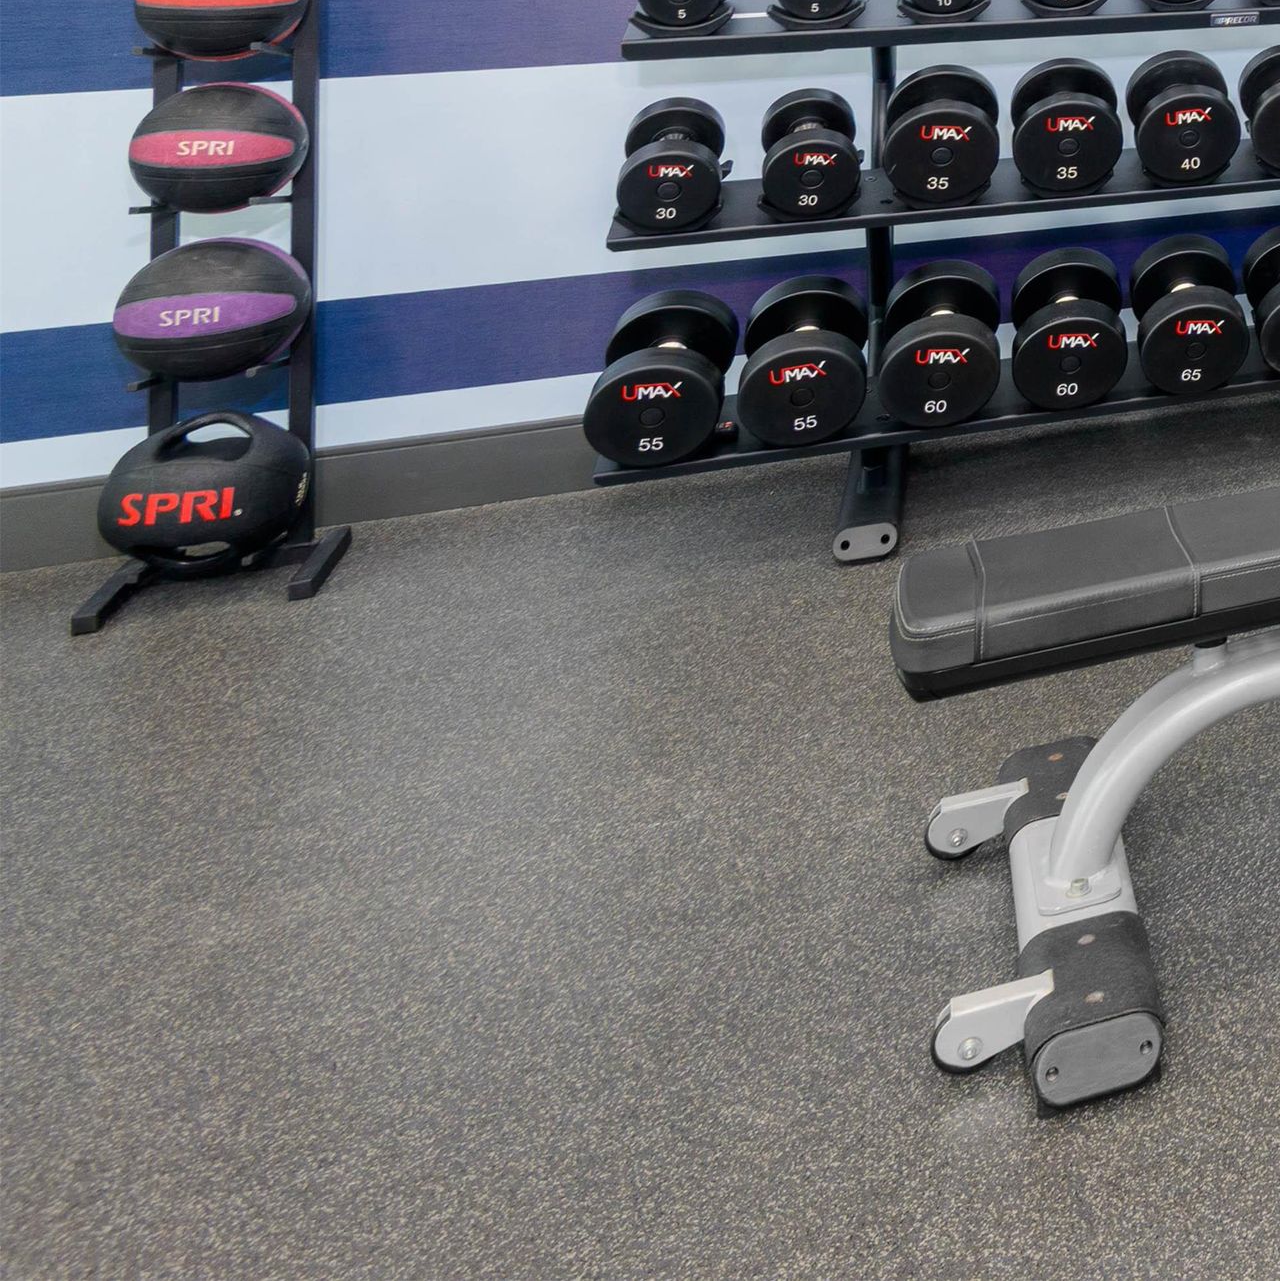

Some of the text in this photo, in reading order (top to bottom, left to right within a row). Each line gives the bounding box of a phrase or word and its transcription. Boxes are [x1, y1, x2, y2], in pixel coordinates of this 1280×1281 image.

[677, 8, 687, 19] 5
[810, 2, 820, 13] 5
[1046, 115, 1096, 133] UMAX
[1165, 106, 1212, 127] UMAX
[919, 125, 972, 142] UMAX
[174, 138, 236, 157] SPRI
[793, 152, 838, 166] UMAX
[1180, 156, 1201, 170] 40
[647, 164, 695, 178] UMAX
[1056, 166, 1078, 180] 35
[926, 176, 949, 190] 35
[798, 194, 818, 206] 30
[655, 207, 677, 220] 30
[158, 306, 222, 328] SPRI
[1175, 319, 1225, 336] UMAX
[1047, 332, 1100, 350] UMAX
[915, 348, 970, 366] UMAX
[768, 360, 827, 386] UMAX
[1181, 368, 1202, 382] 65
[621, 381, 683, 402] UMAX
[1056, 382, 1079, 396] 60
[924, 399, 948, 414] 60
[793, 414, 818, 431] 55
[638, 436, 664, 452] 55
[117, 486, 236, 527] SPRI
